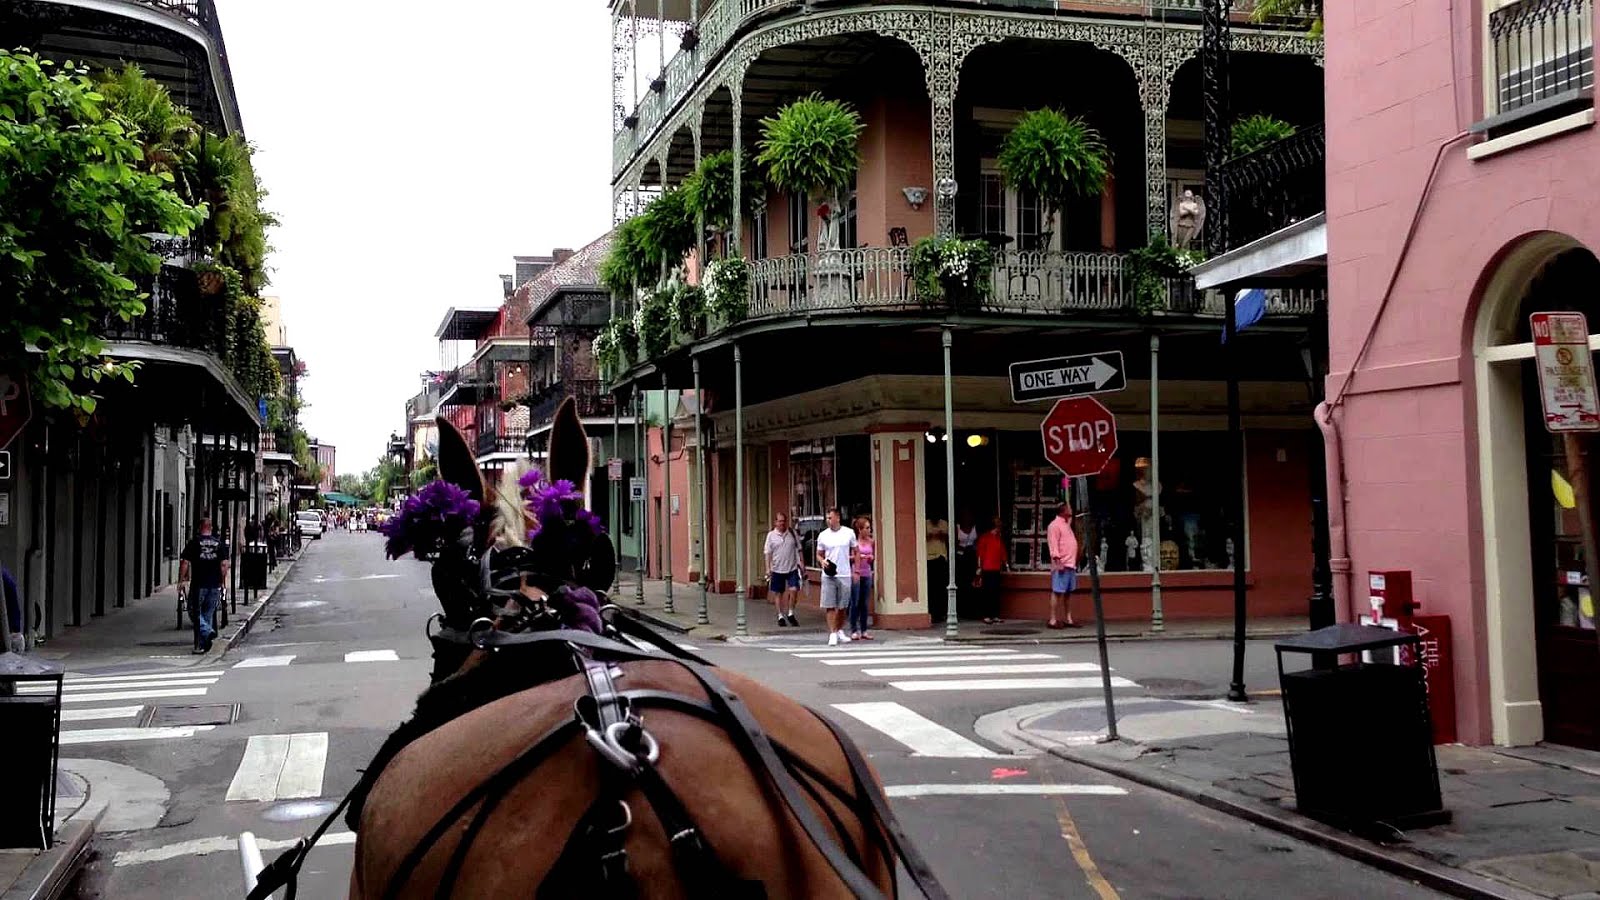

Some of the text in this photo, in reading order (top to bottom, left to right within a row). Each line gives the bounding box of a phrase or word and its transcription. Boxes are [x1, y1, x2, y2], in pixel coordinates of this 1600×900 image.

[1534, 321, 1549, 338] NO
[1024, 366, 1090, 388] ONE WAY
[1048, 419, 1110, 454] STOP
[1427, 637, 1440, 667] THE
